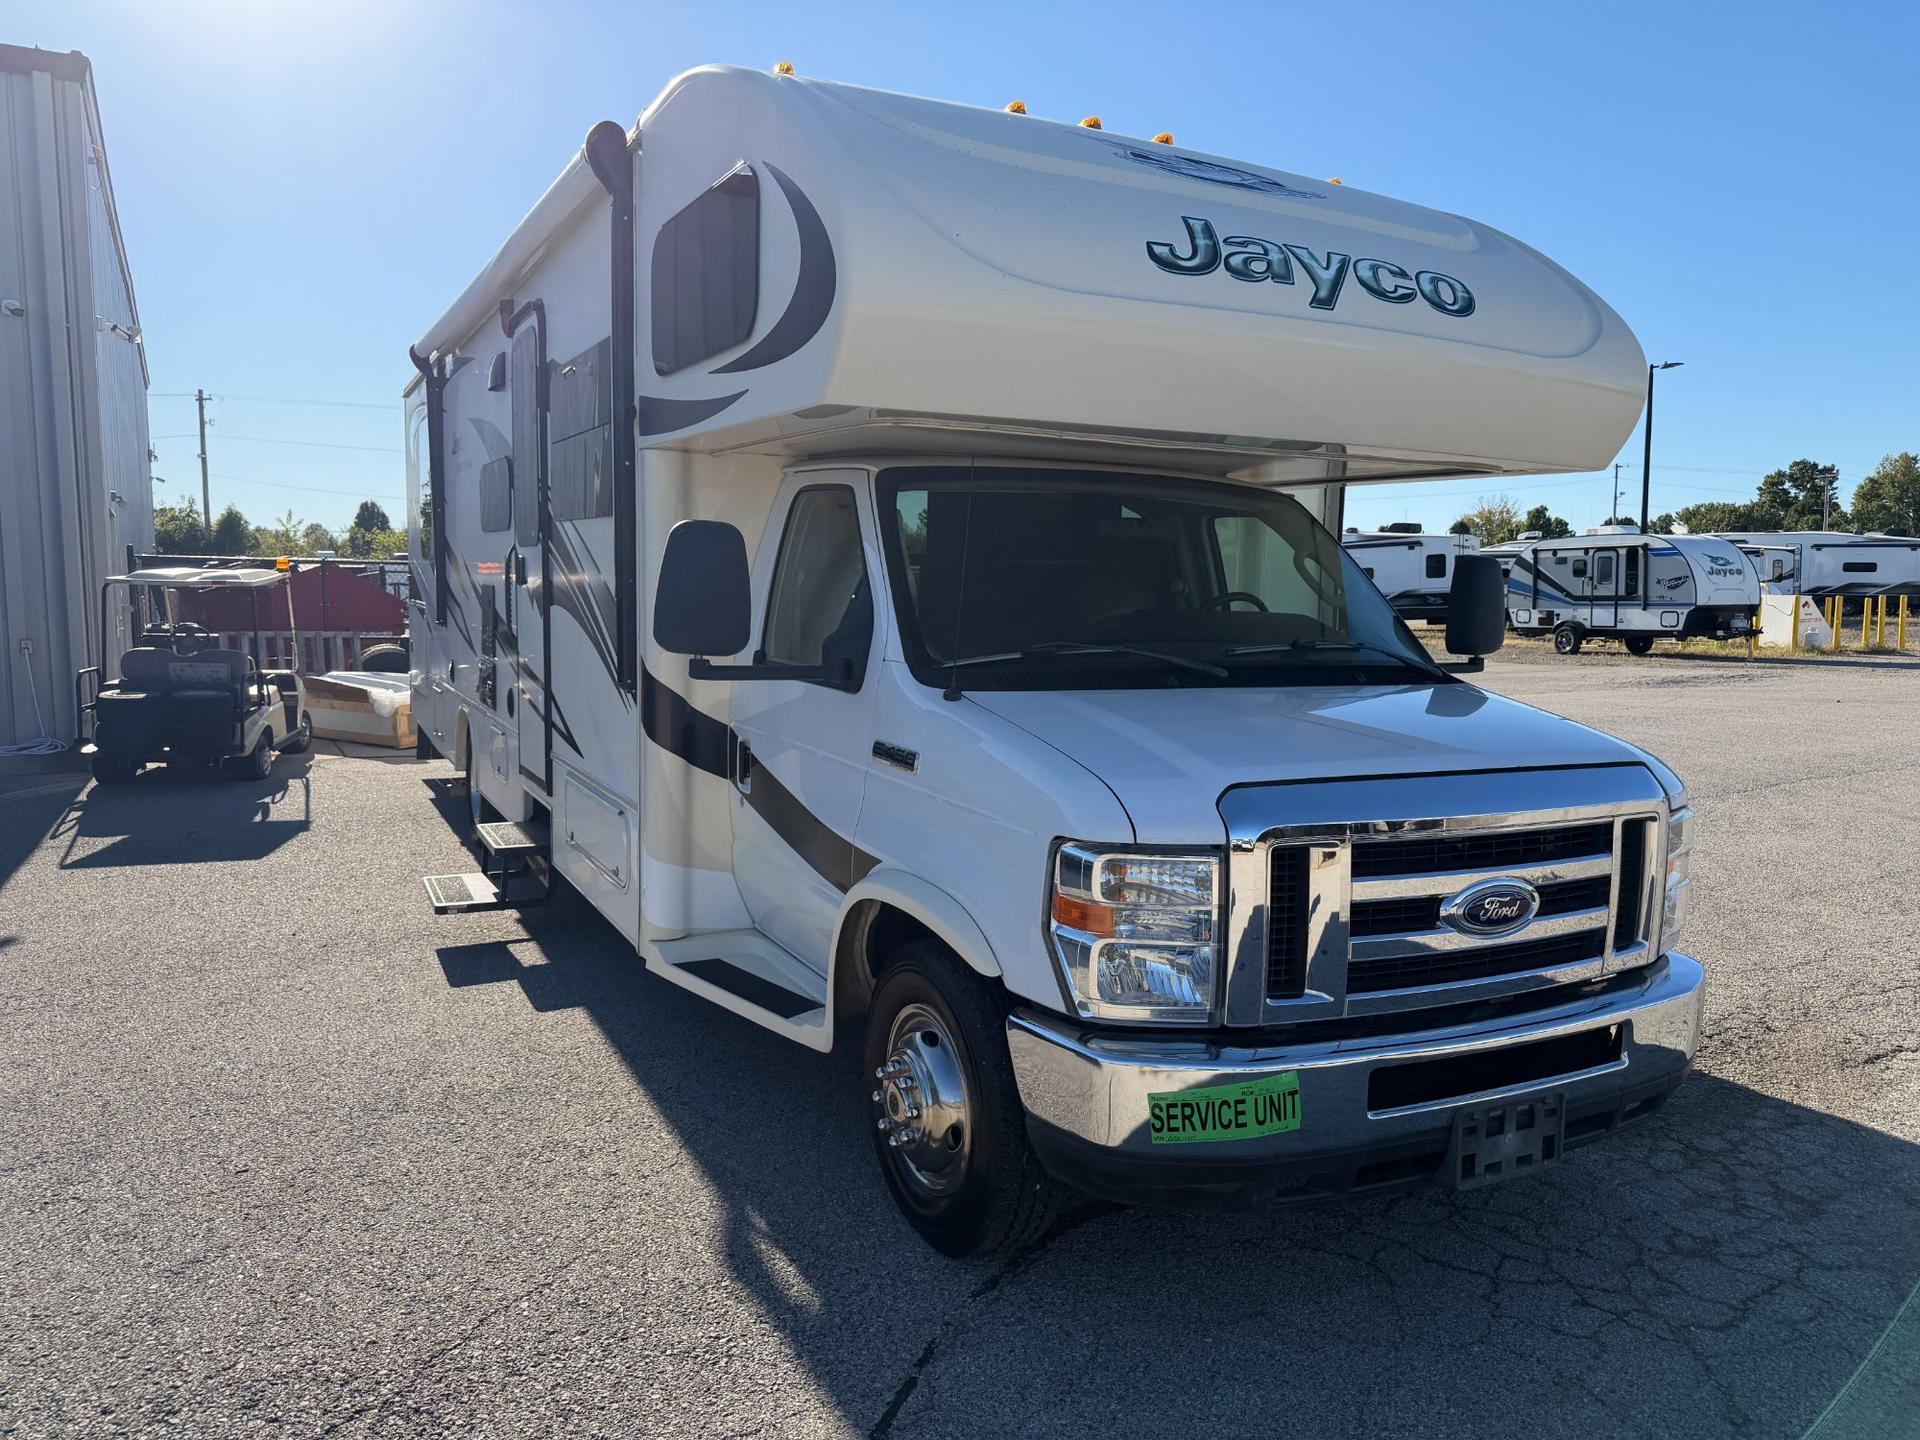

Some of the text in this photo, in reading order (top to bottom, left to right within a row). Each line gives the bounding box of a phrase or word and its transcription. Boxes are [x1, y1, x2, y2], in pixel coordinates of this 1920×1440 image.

[1146, 215, 1476, 318] Jayco
[1707, 566, 1743, 577] Jayco
[1480, 896, 1520, 920] Ford
[1151, 1089, 1299, 1134] SERVICE UNIT
